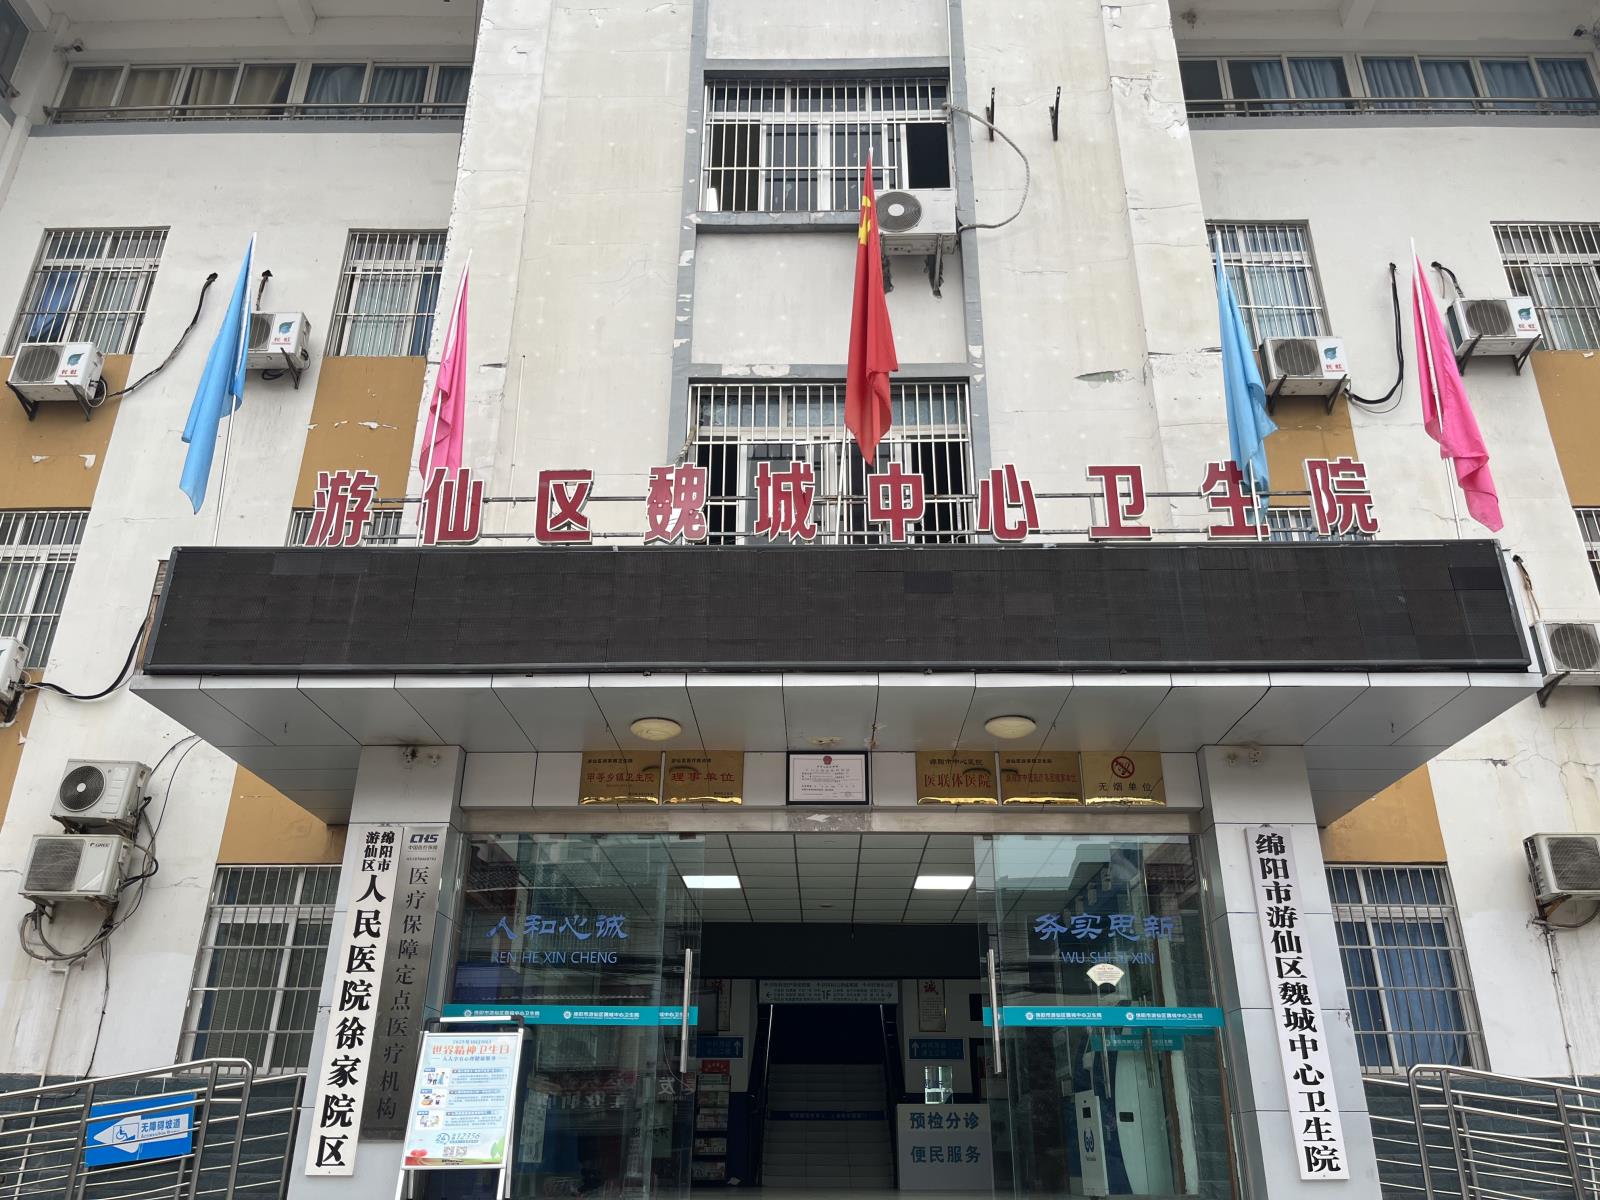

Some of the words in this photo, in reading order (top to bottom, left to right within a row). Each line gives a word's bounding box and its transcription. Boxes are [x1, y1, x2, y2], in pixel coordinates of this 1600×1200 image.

[305, 456, 1379, 549] 游仙区魏城中心卫生院
[586, 772, 656, 783] 甲等乡镇卫生院
[671, 772, 736, 782] 理事单位
[924, 773, 992, 789] 医联体医院
[1098, 782, 1153, 792] 无烟单位
[361, 831, 381, 872] 游仙区
[377, 831, 396, 873] 绵阳市
[485, 913, 629, 941] 人和心诚
[1034, 913, 1175, 942] 务实思新
[492, 951, 517, 964] REN
[522, 951, 539, 964] HE
[543, 951, 567, 964] XIN
[570, 951, 617, 964] CHENG
[1061, 951, 1085, 964] WU
[1089, 951, 1112, 964] SHI
[1131, 951, 1155, 964] XIN
[376, 866, 429, 1121] 医疗保障定点医疗机构
[1255, 832, 1342, 1173] 绵阳市游仙区魏城中心卫生院
[315, 874, 387, 1169] 人民医院徐家院区
[432, 1045, 510, 1055] 世界精神卫生日
[140, 1118, 181, 1133] 无障碍坡道
[909, 1112, 980, 1130] 预检分诊
[910, 1145, 982, 1164] 便民服务
